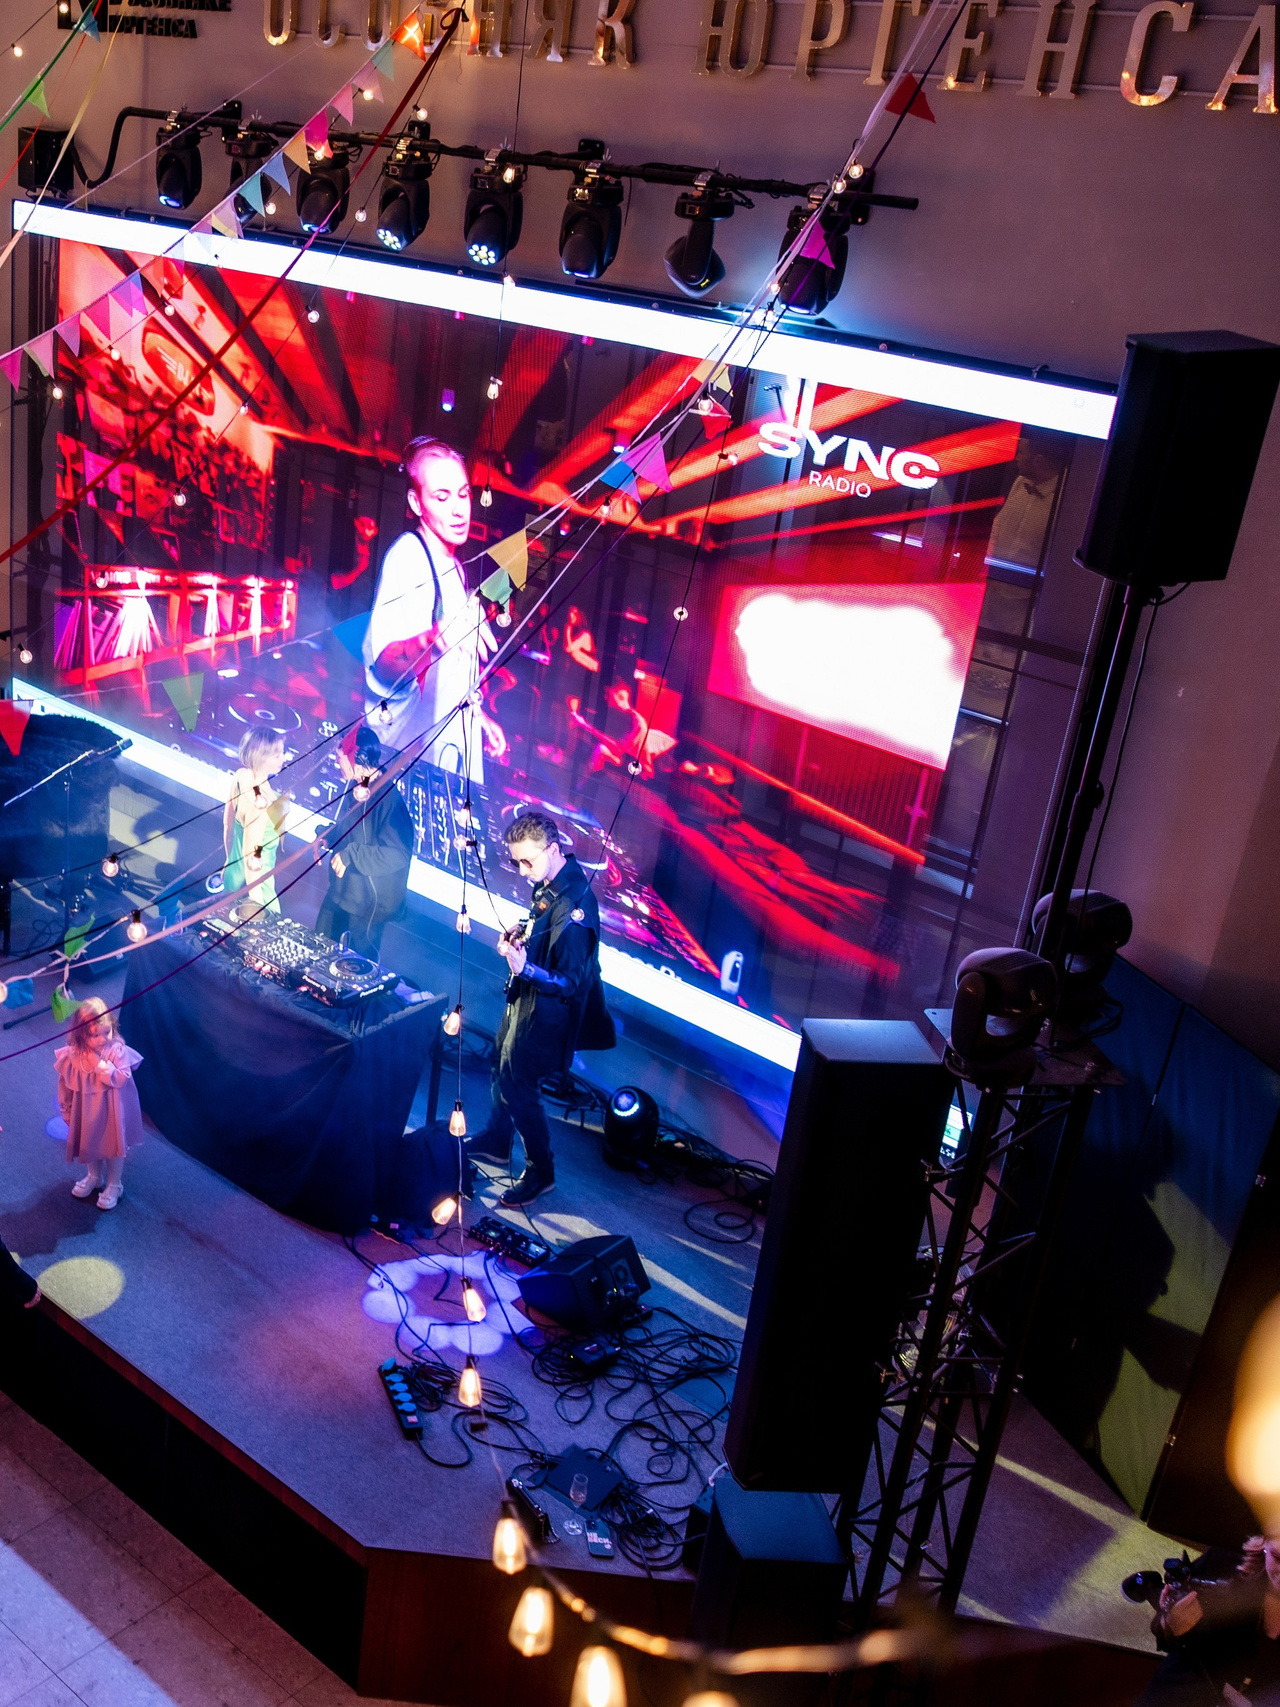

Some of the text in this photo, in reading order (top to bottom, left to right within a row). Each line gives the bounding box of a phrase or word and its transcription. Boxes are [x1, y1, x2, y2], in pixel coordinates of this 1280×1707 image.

[690, 0, 1279, 114] ЮРГЕНСА
[758, 421, 940, 489] SYNC
[809, 470, 871, 498] RADIO
